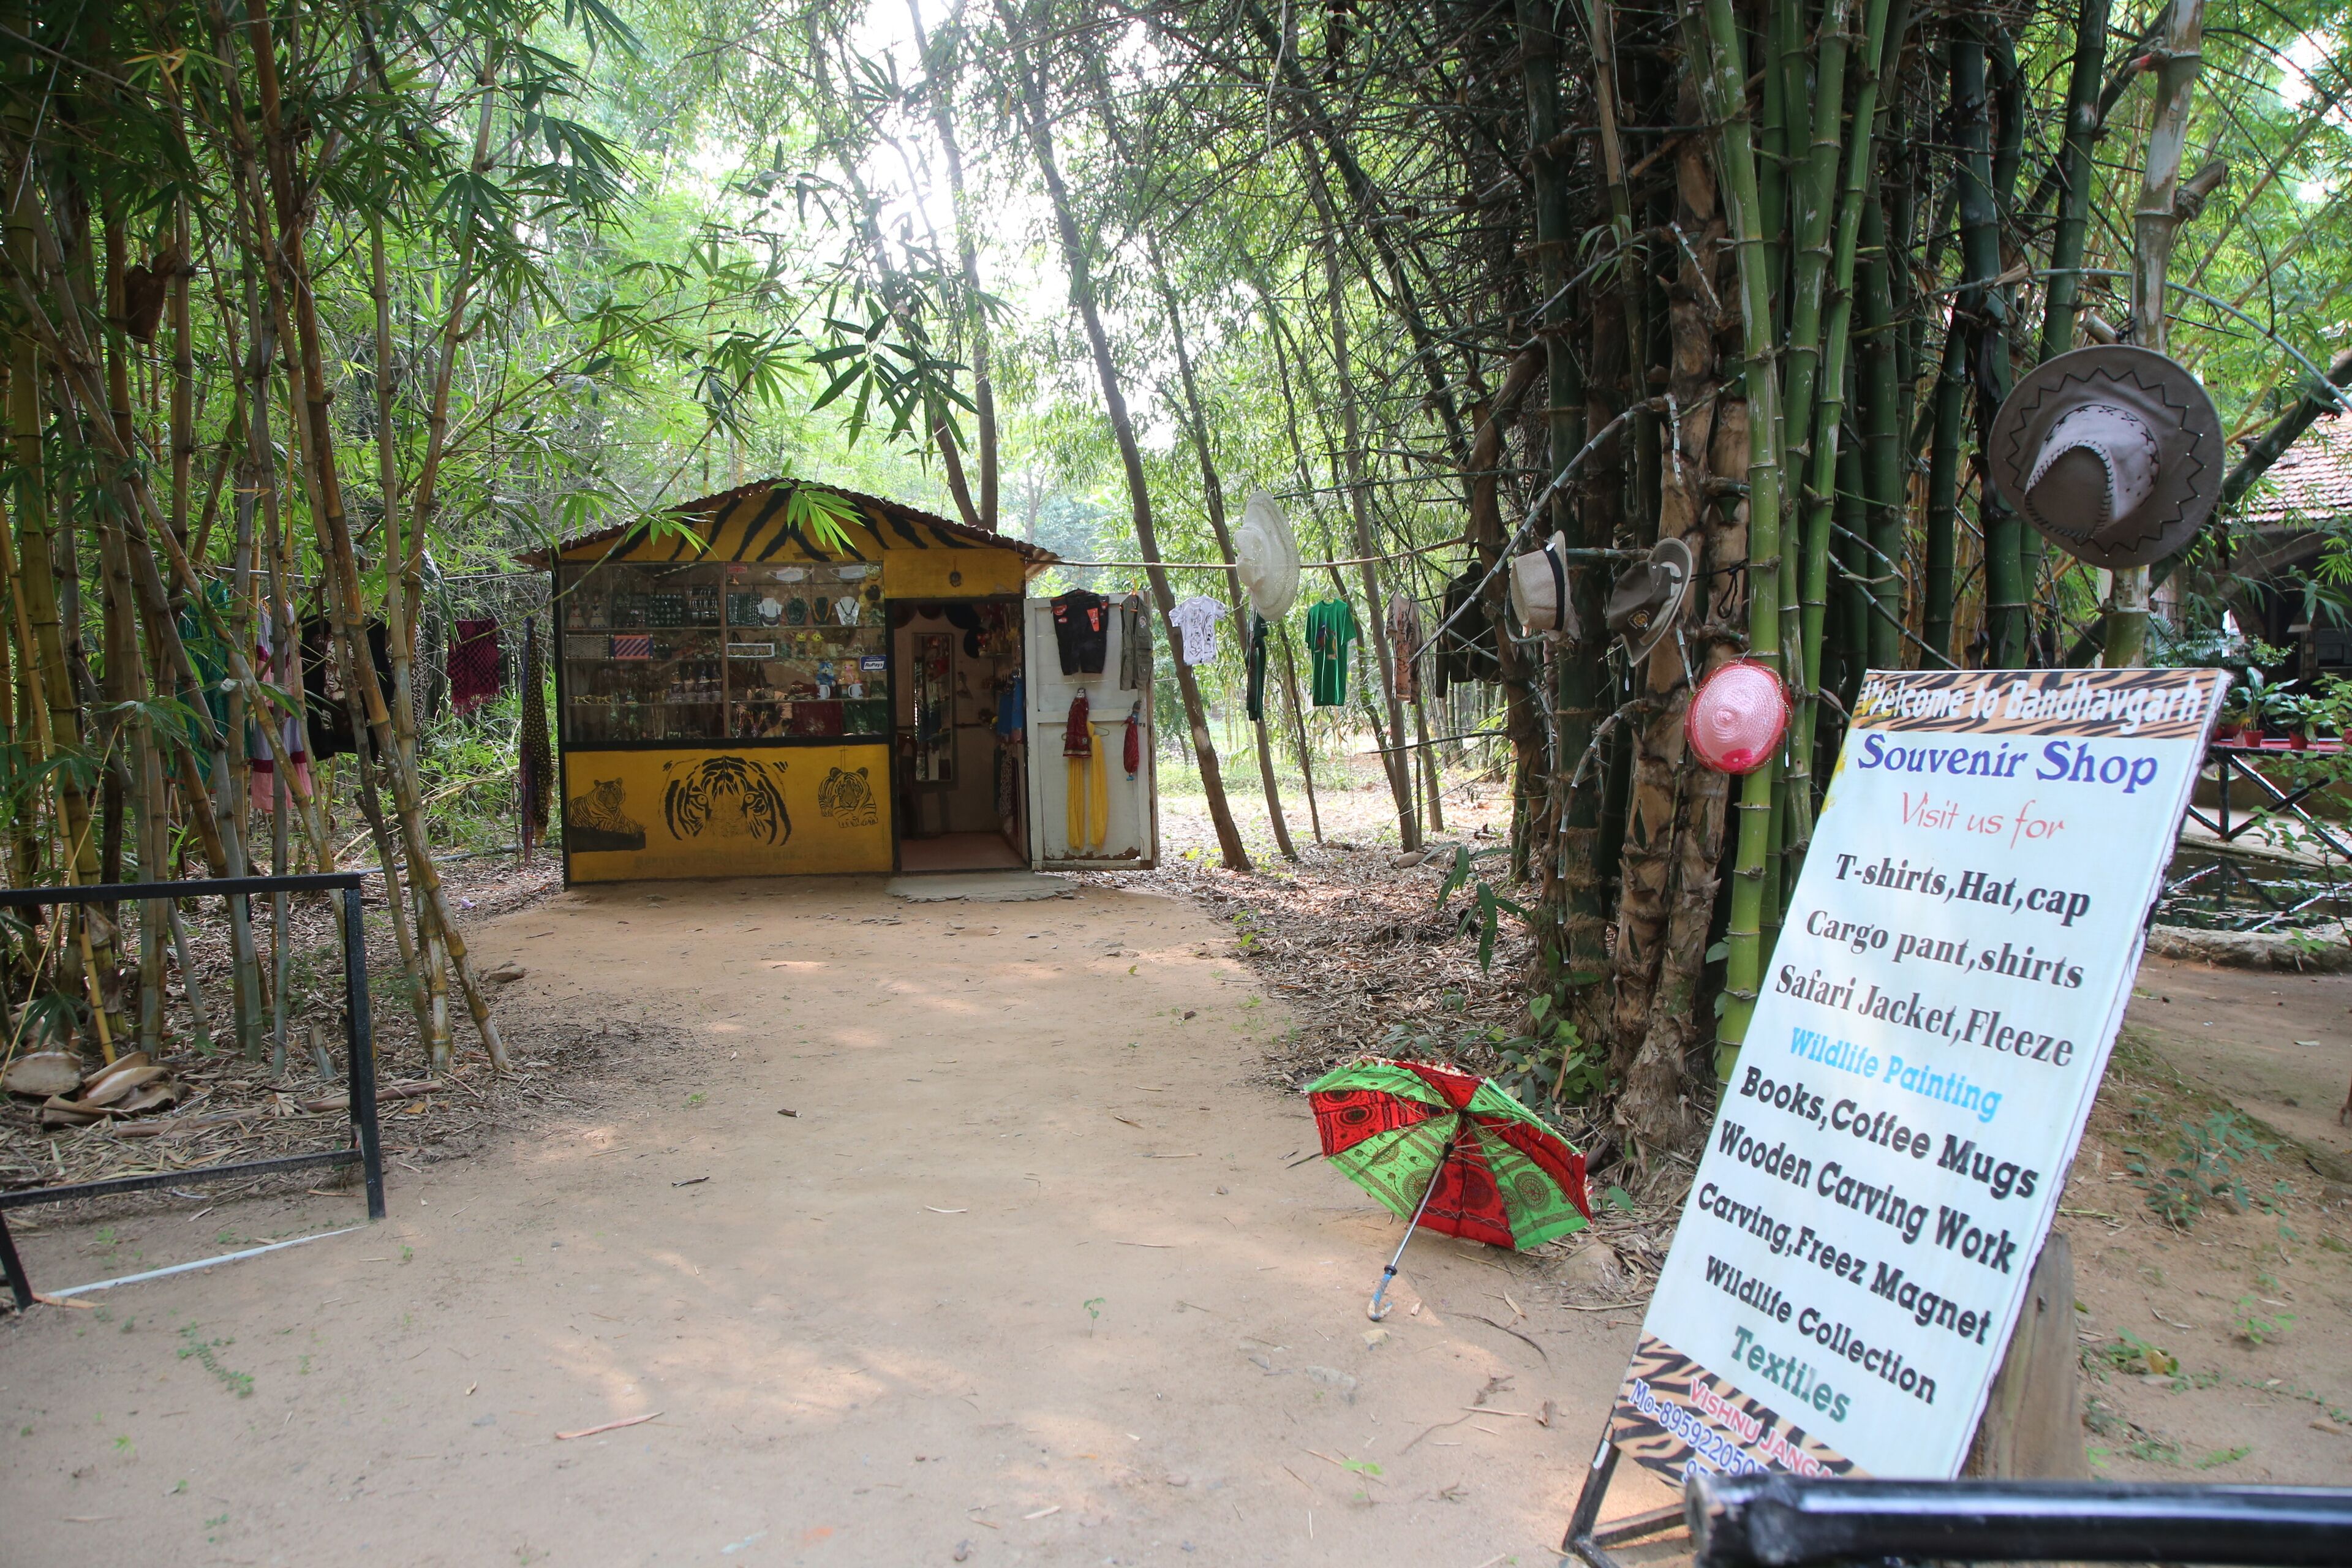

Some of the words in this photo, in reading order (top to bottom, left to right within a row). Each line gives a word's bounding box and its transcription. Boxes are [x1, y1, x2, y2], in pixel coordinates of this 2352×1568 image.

[1862, 679, 1965, 718] Welcome
[1972, 682, 1999, 719] to
[2005, 677, 2203, 734] Bandhavgarh
[1858, 733, 2029, 778] Souvenir
[2036, 741, 2158, 793] Shop
[1902, 791, 1960, 831] Visit
[1966, 814, 2003, 834] us
[2010, 801, 2065, 850] for
[1807, 911, 1888, 954] Cargo
[1892, 934, 2084, 988] pant,shirts
[1776, 965, 1856, 1010] Safari
[1791, 1027, 1879, 1077] Wildlife
[1883, 1055, 2003, 1123] Painting
[1719, 1120, 1812, 1188] Wooden
[1817, 1161, 1930, 1245] Carving
[1936, 1205, 2018, 1275] Work
[1937, 1134, 2040, 1200] Mugs
[1706, 1256, 1792, 1323] Wildlife
[1798, 1308, 1937, 1405] Collection
[1870, 1261, 1992, 1346] Magnet
[1732, 1325, 1850, 1422] Textiles
[1689, 1378, 1762, 1443] VISHNU
